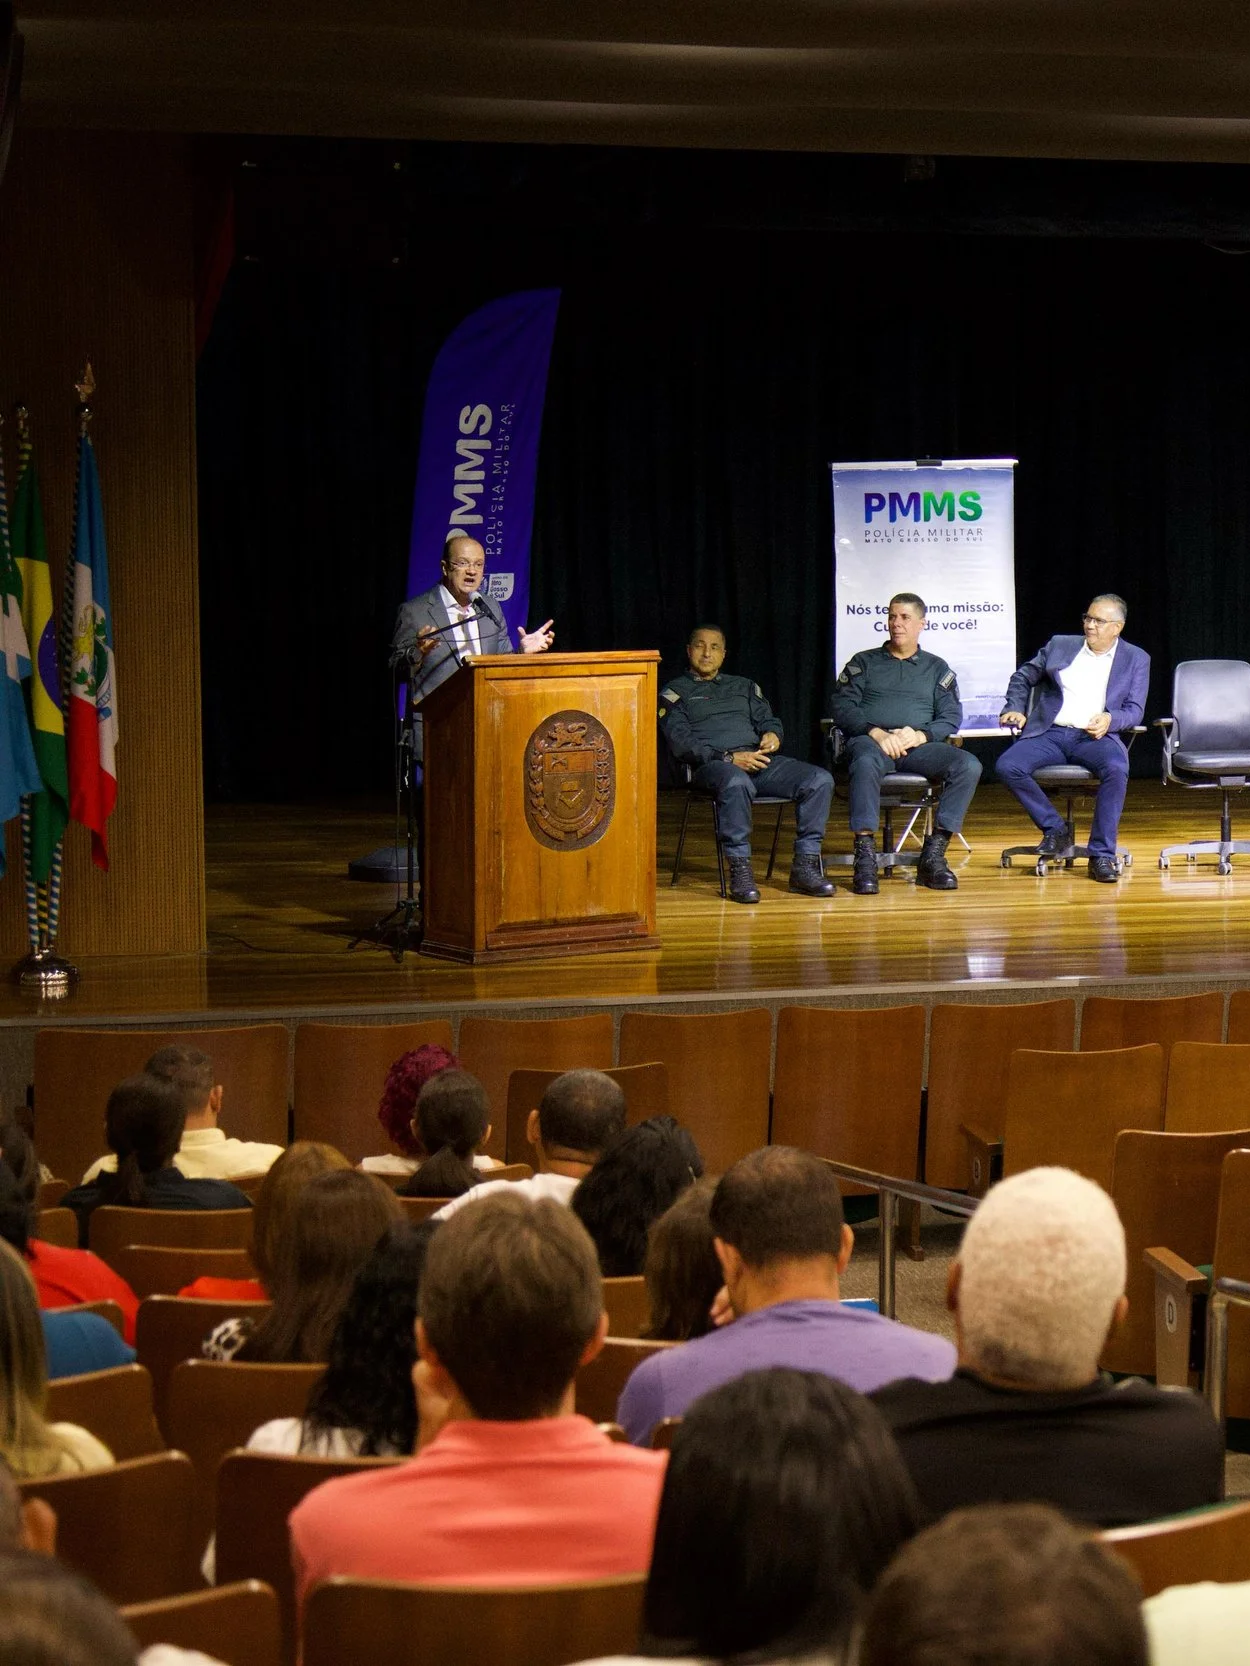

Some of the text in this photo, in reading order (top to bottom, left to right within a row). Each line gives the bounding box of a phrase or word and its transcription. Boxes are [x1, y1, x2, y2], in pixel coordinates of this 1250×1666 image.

[492, 404, 510, 474] MILITAR
[864, 490, 983, 524] PMMS
[864, 528, 983, 538] POLÍCIA MILITAR
[846, 604, 871, 615] Nós
[953, 601, 1004, 613] missão:
[924, 619, 977, 630] de você!
